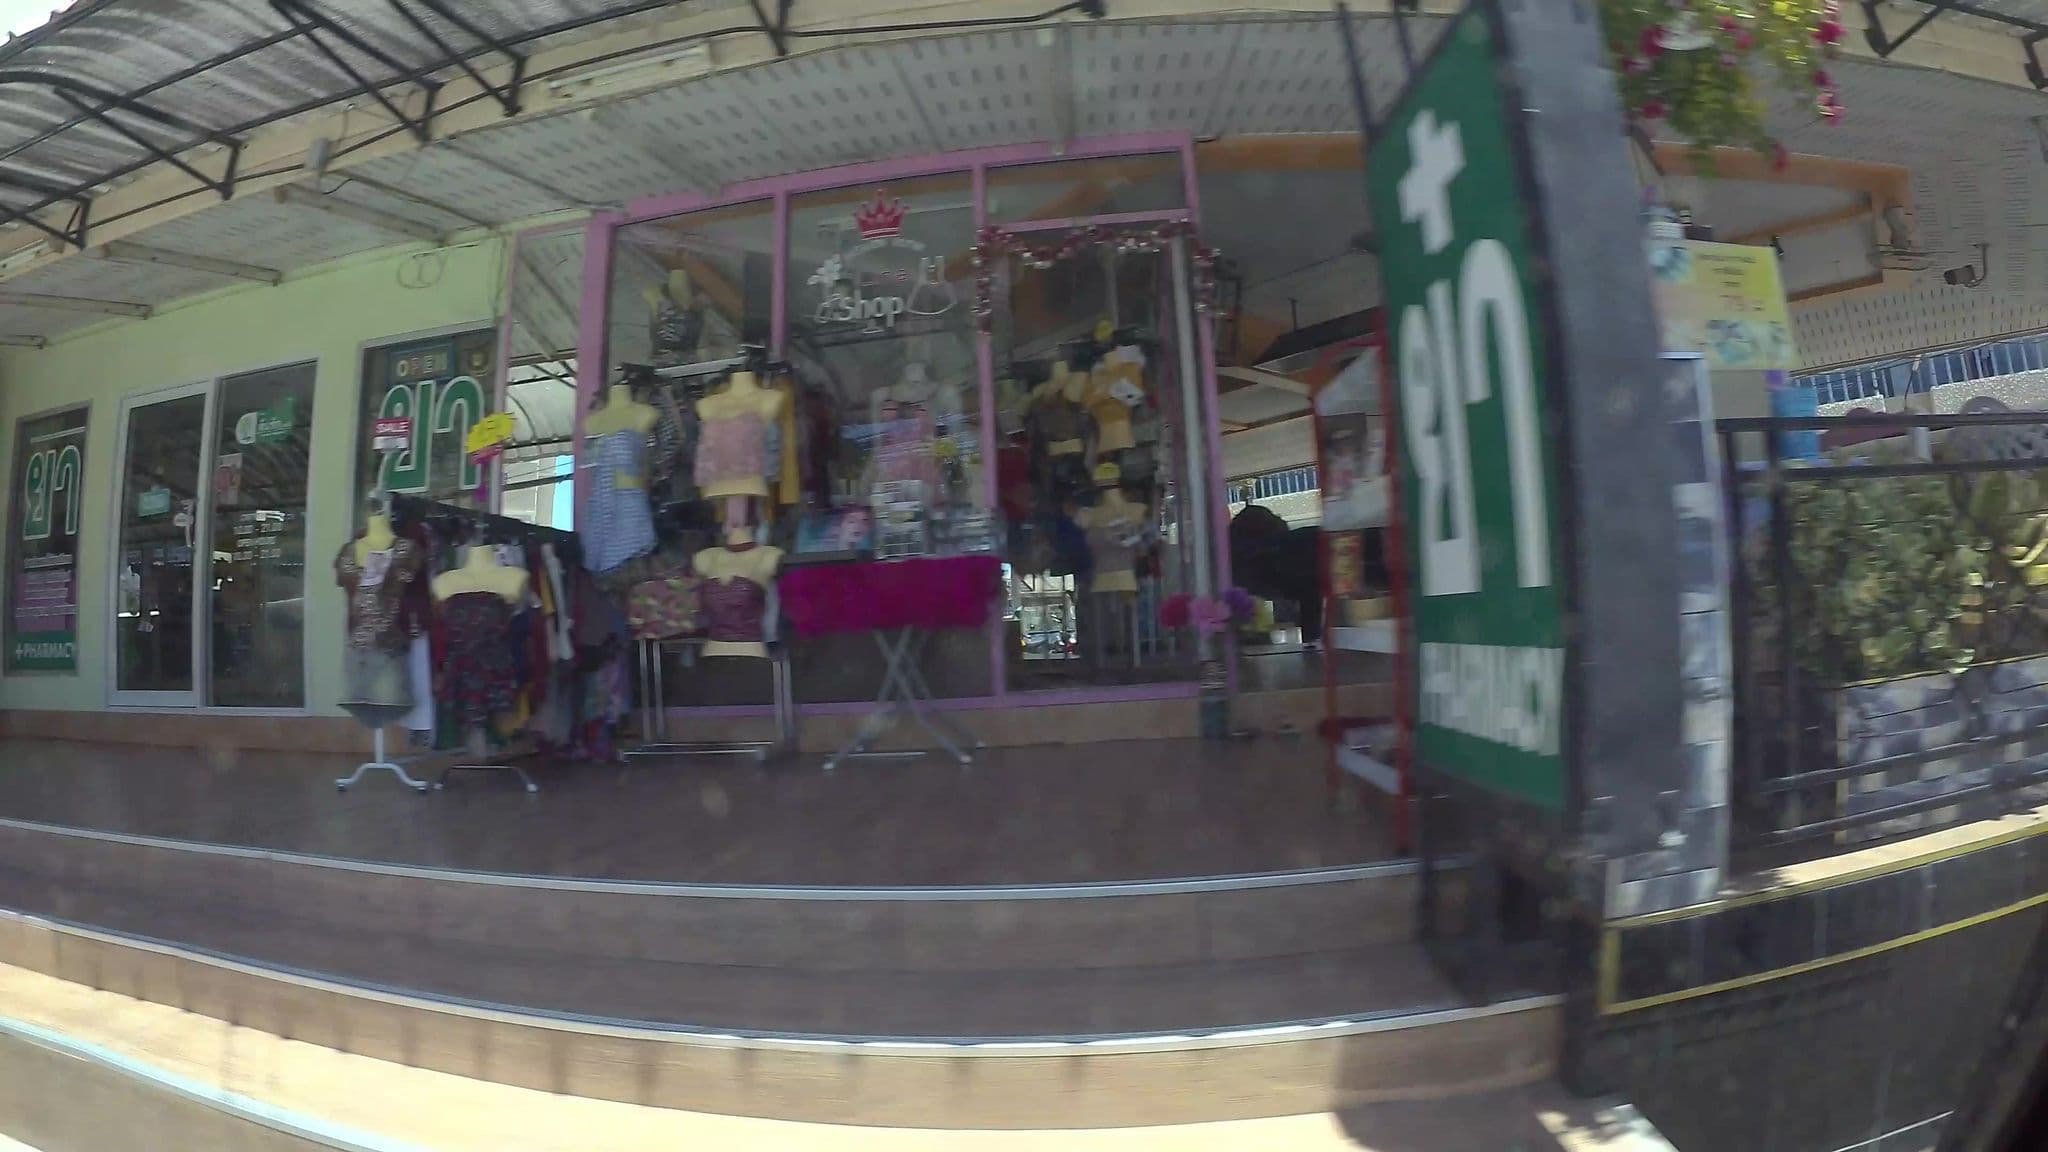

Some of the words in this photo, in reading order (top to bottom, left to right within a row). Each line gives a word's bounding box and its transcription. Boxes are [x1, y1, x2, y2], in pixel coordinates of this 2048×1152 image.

[396, 352, 448, 377] OPEN
[1400, 238, 1551, 597] ยา
[377, 376, 485, 493] ยา
[23, 445, 81, 540] ยา
